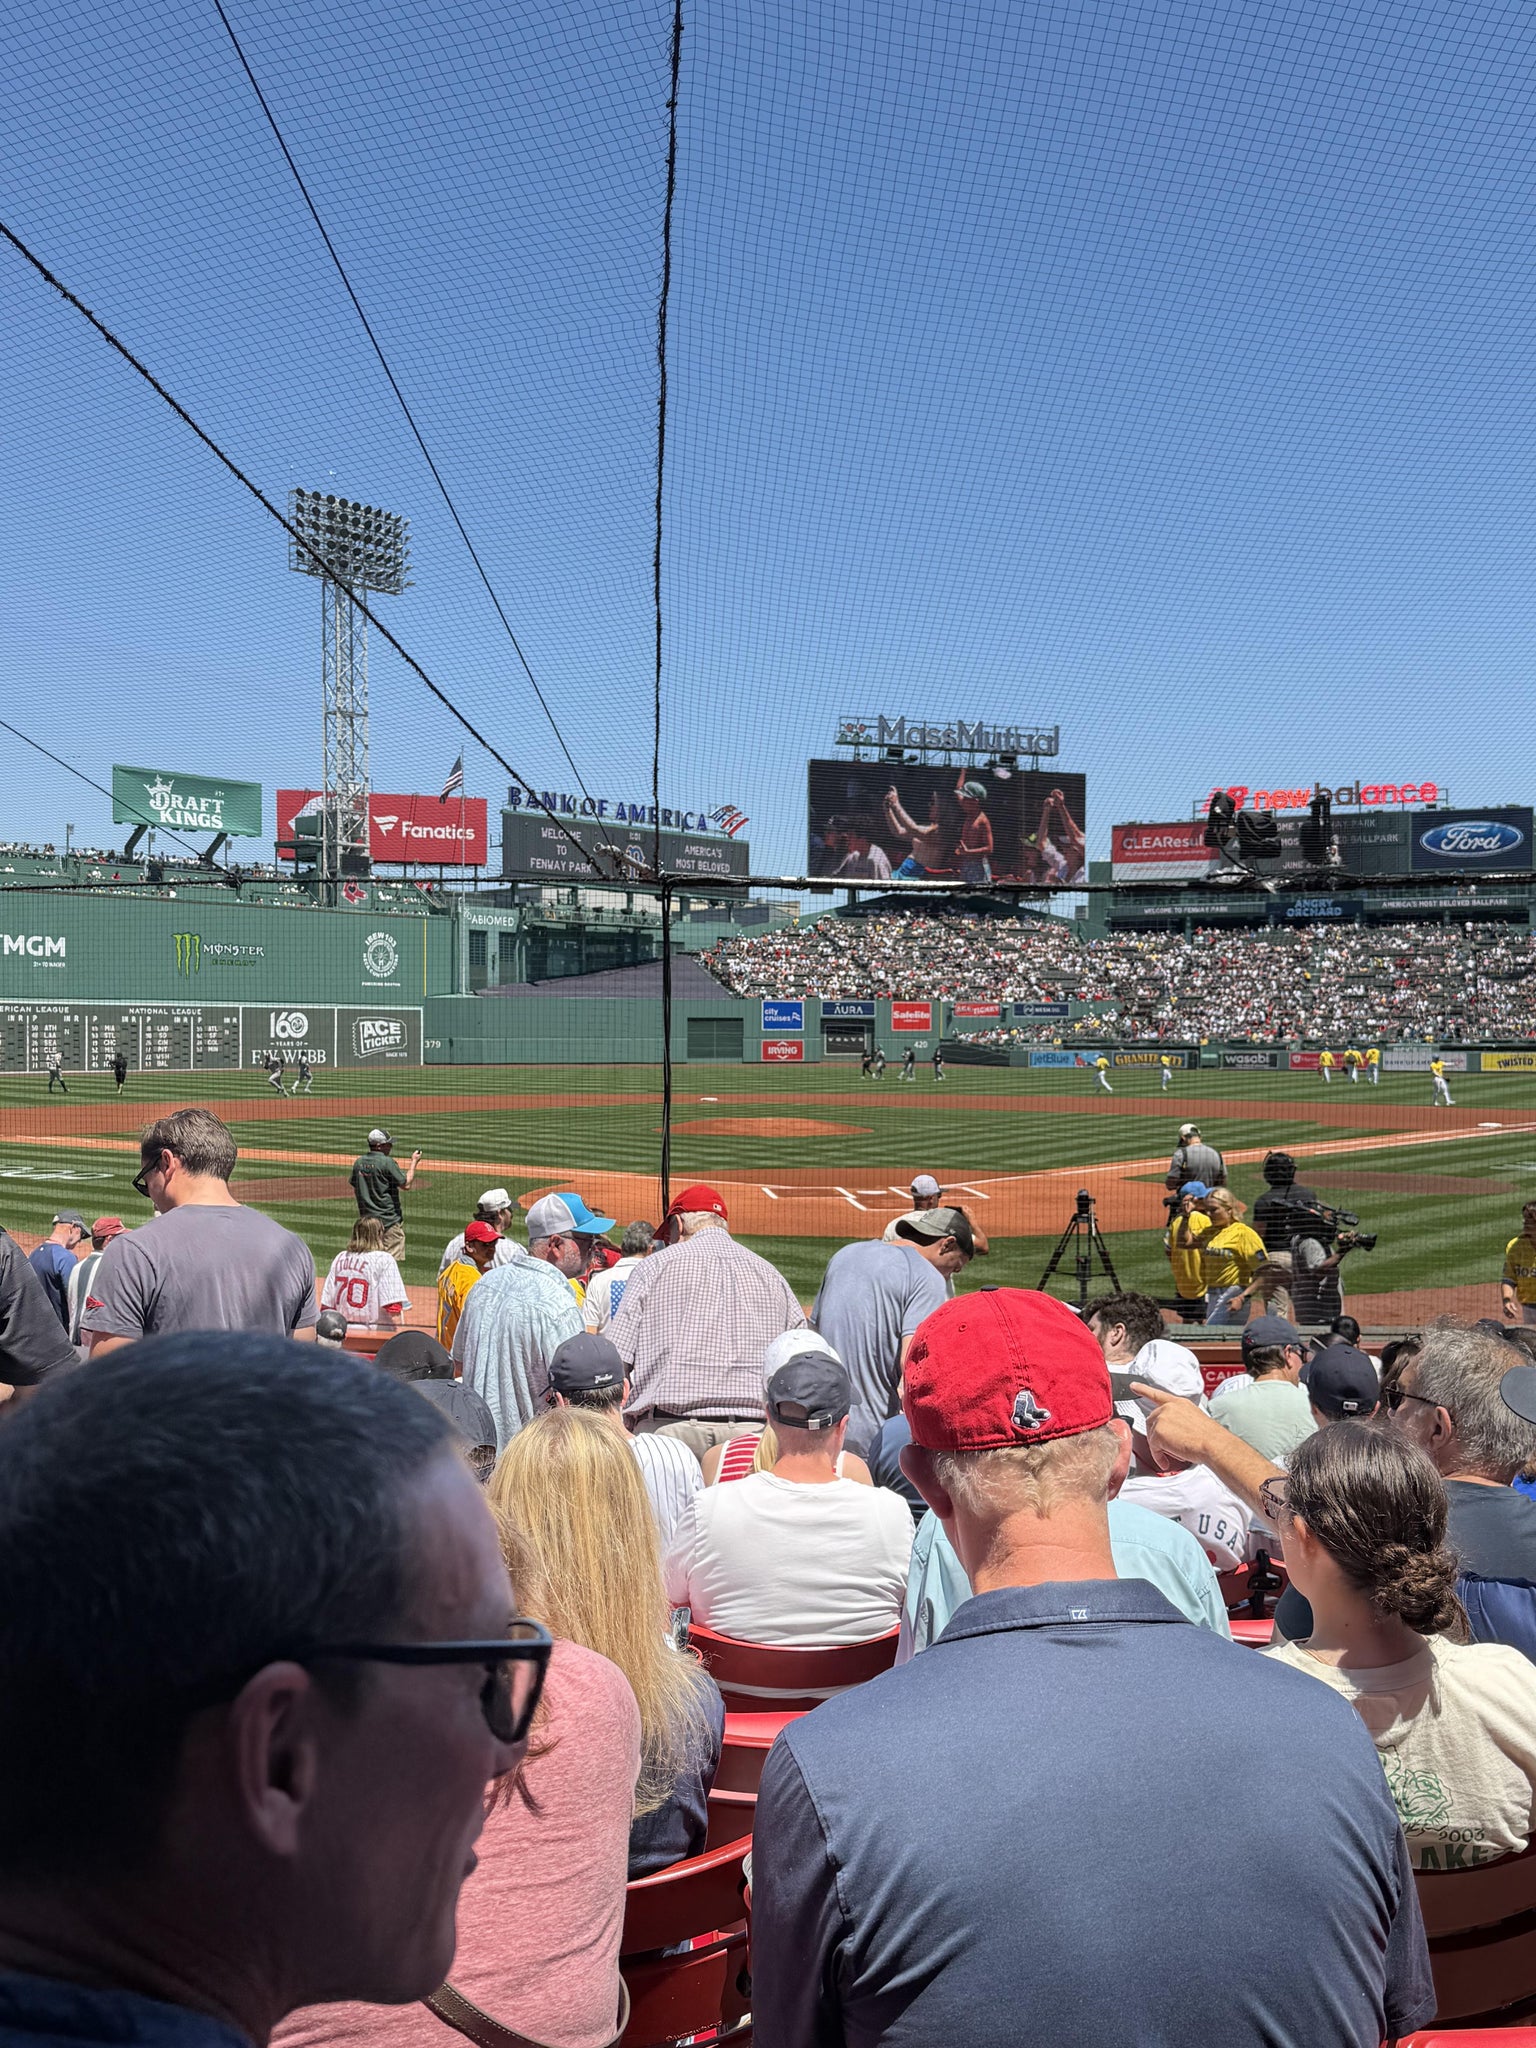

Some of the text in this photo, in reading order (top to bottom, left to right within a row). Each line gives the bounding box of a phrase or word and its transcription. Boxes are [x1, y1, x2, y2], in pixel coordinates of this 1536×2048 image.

[878, 714, 1059, 753] MassMutual
[1254, 787, 1311, 810] new
[1314, 780, 1438, 805] balance
[150, 791, 224, 814] DRAFT
[509, 786, 708, 831] BANK OF AMERICA
[160, 808, 223, 829] KINGS
[402, 821, 475, 840] Fanatics
[541, 827, 582, 841] WELCOME
[1121, 834, 1206, 850] CLEAResul
[1440, 825, 1502, 851] Ford
[556, 845, 567, 856] TO
[684, 845, 723, 859] AMERICA'S
[530, 857, 592, 874] FENWAY PARK
[675, 859, 731, 873] MOST BELOVED
[1295, 899, 1334, 908] ANGRY
[1286, 907, 1342, 917] ORCHARD
[471, 914, 514, 927] ABIOMED
[0, 934, 66, 958] MGM
[203, 942, 265, 956] MONSTER
[36, 1006, 69, 1014] LEAGUE
[129, 1007, 168, 1015] NATIONAL
[764, 1008, 778, 1016] city
[893, 1010, 930, 1019] Safelite
[363, 1020, 401, 1038] ACE
[364, 1036, 402, 1049] TICKET
[424, 1040, 441, 1049] 379
[914, 1041, 928, 1049] 420
[768, 1046, 798, 1055] IRVING
[1033, 1052, 1069, 1065] jetBlue
[1115, 1053, 1159, 1066] GRANITE
[1225, 1052, 1270, 1064] wasabi
[1497, 1057, 1533, 1069] TWISTED
[339, 1257, 369, 1274] TOLLE
[334, 1276, 369, 1308] 70
[1198, 1513, 1239, 1551] USA
[1438, 1827, 1486, 1842] 2003
